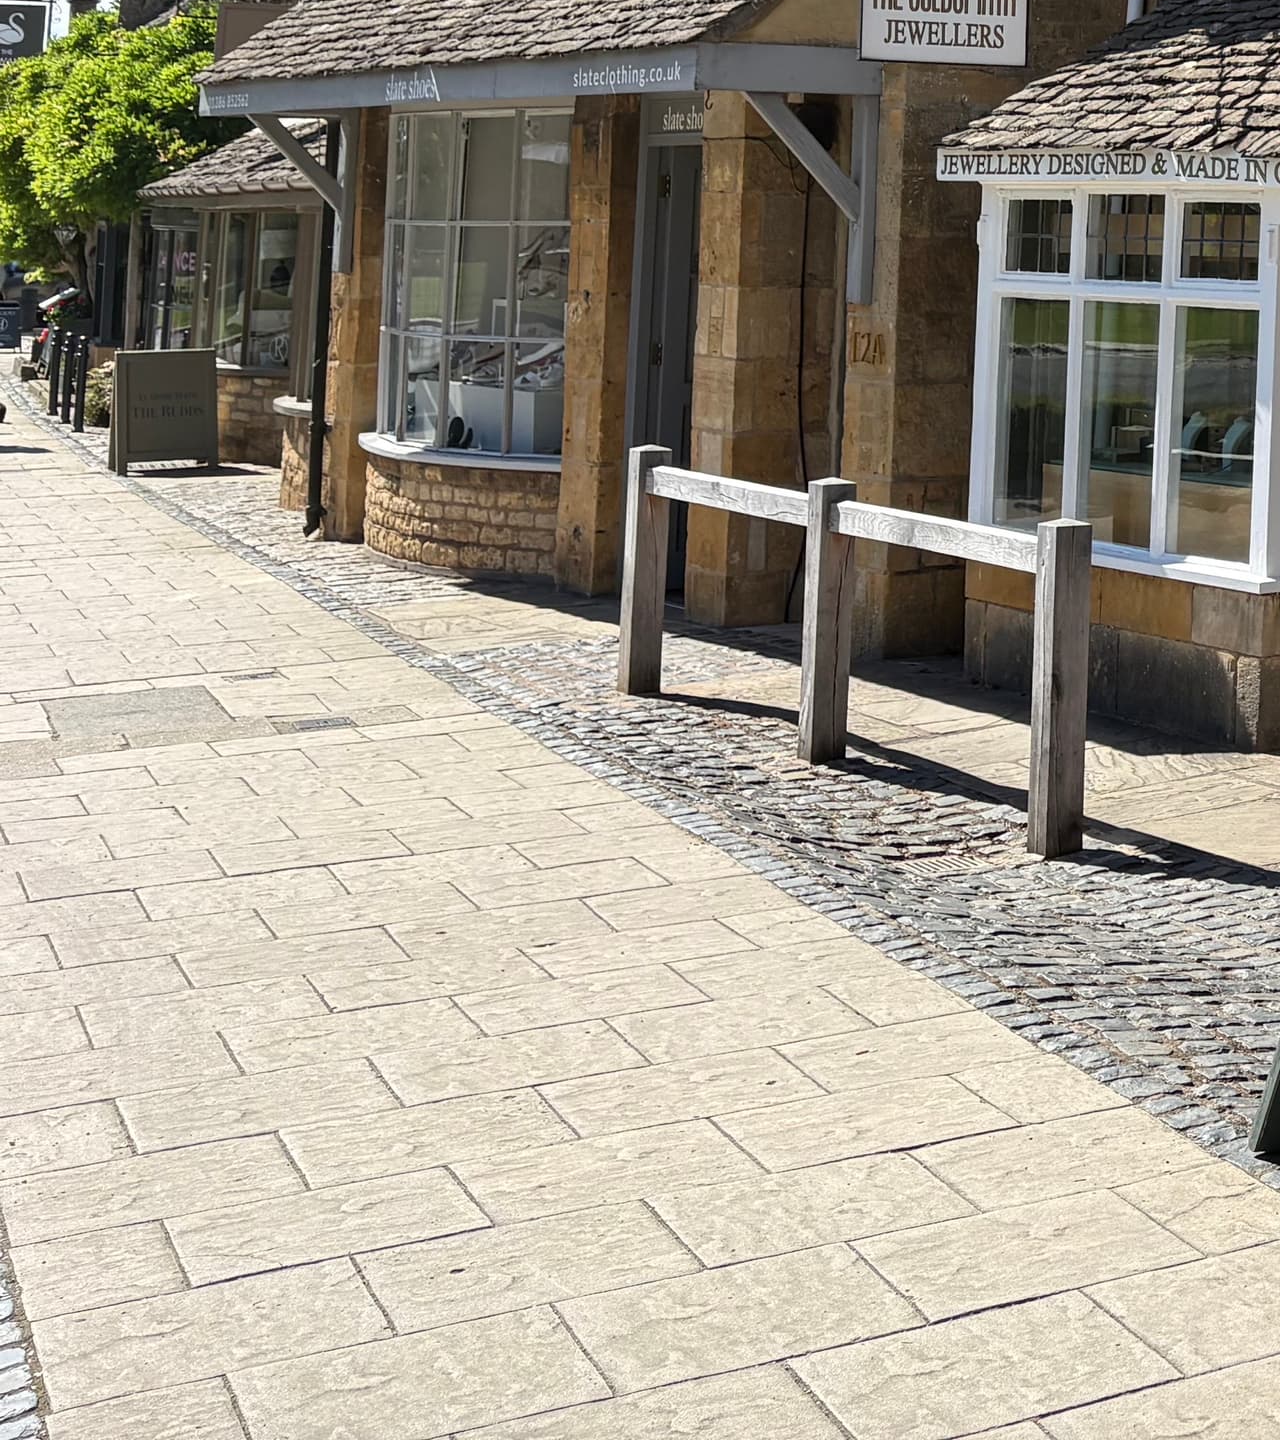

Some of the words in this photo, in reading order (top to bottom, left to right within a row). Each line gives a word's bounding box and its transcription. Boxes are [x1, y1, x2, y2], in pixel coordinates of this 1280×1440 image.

[883, 19, 1005, 49] JEWELLERS
[573, 60, 681, 88] slateclothing.co.uk
[662, 106, 685, 131] slate
[940, 154, 1045, 175] JEWELLERY
[1047, 152, 1146, 176] DESIGNED
[1151, 152, 1168, 175] &
[1175, 153, 1240, 180] MADE
[1245, 158, 1269, 185] IN
